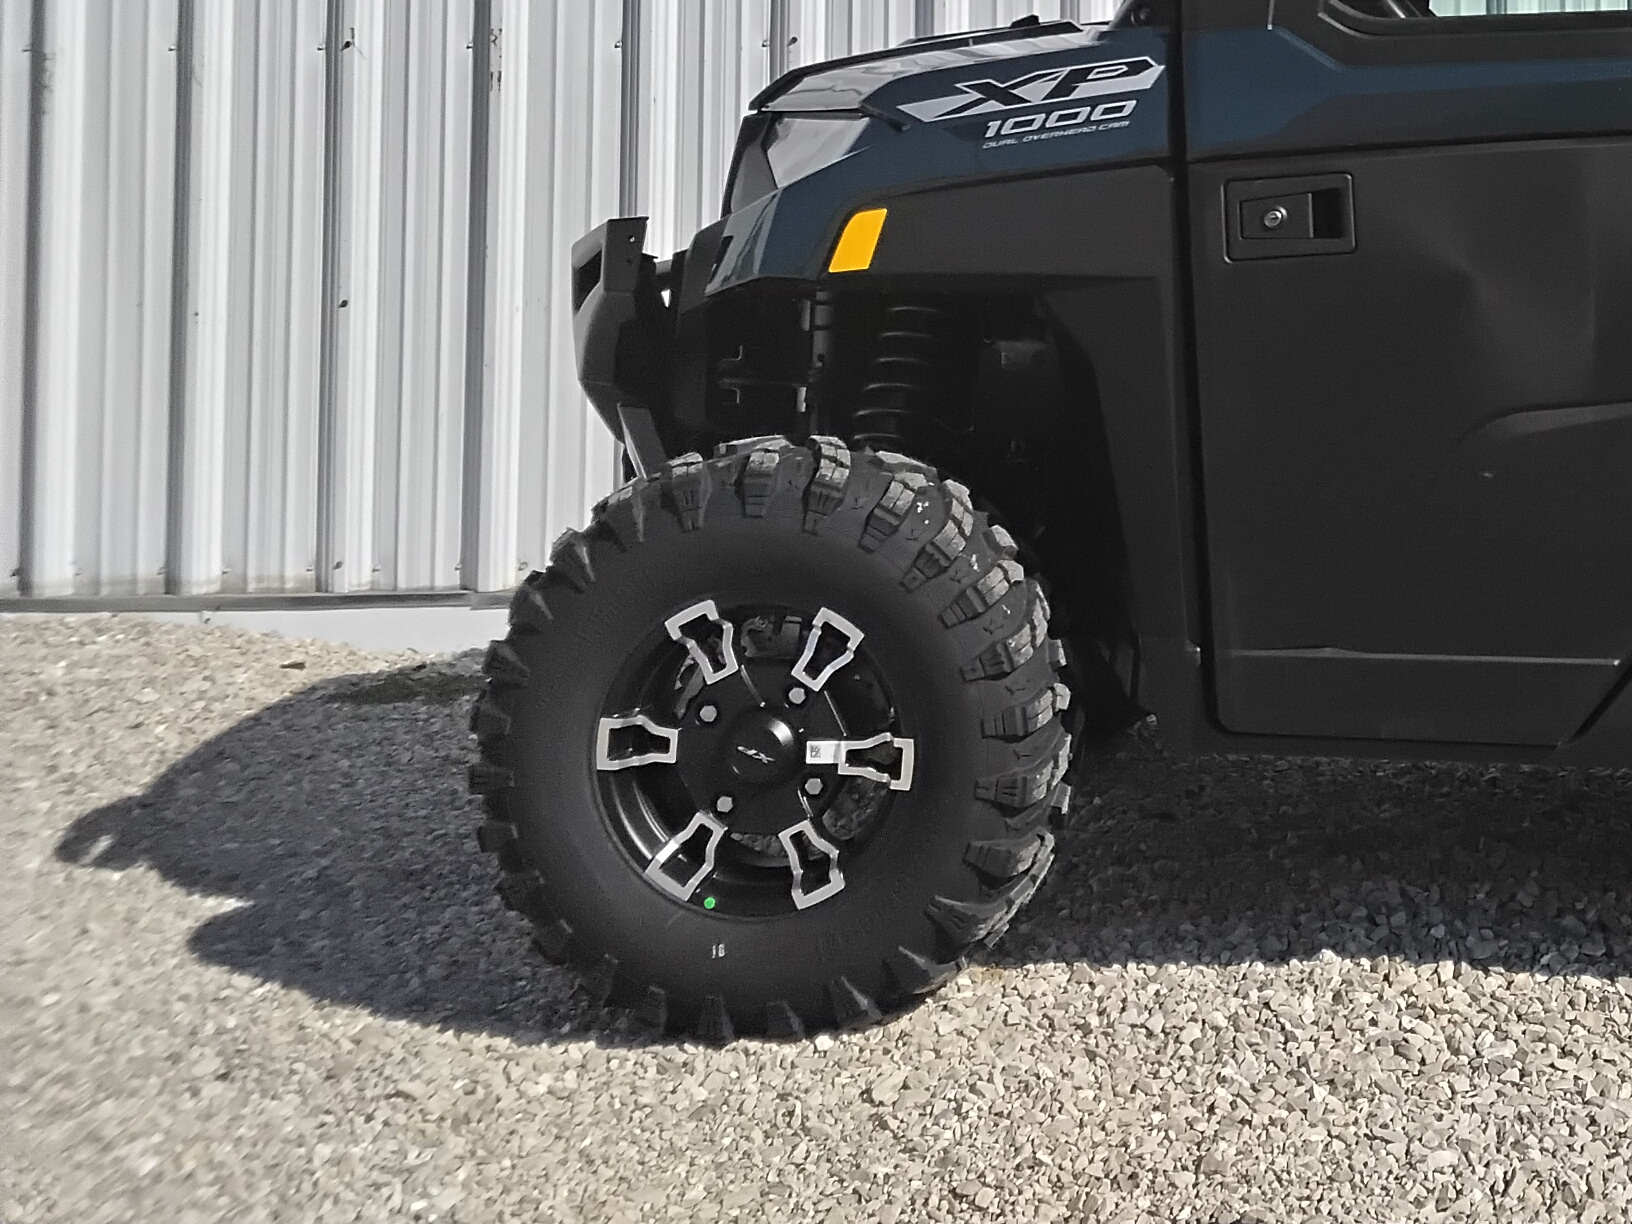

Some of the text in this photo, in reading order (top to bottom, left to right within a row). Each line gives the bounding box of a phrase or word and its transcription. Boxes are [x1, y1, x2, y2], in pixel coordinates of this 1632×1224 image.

[930, 55, 1158, 121] XP
[982, 120, 1131, 149] DUAL OVERHEAD CAM
[984, 99, 1138, 138] 1000
